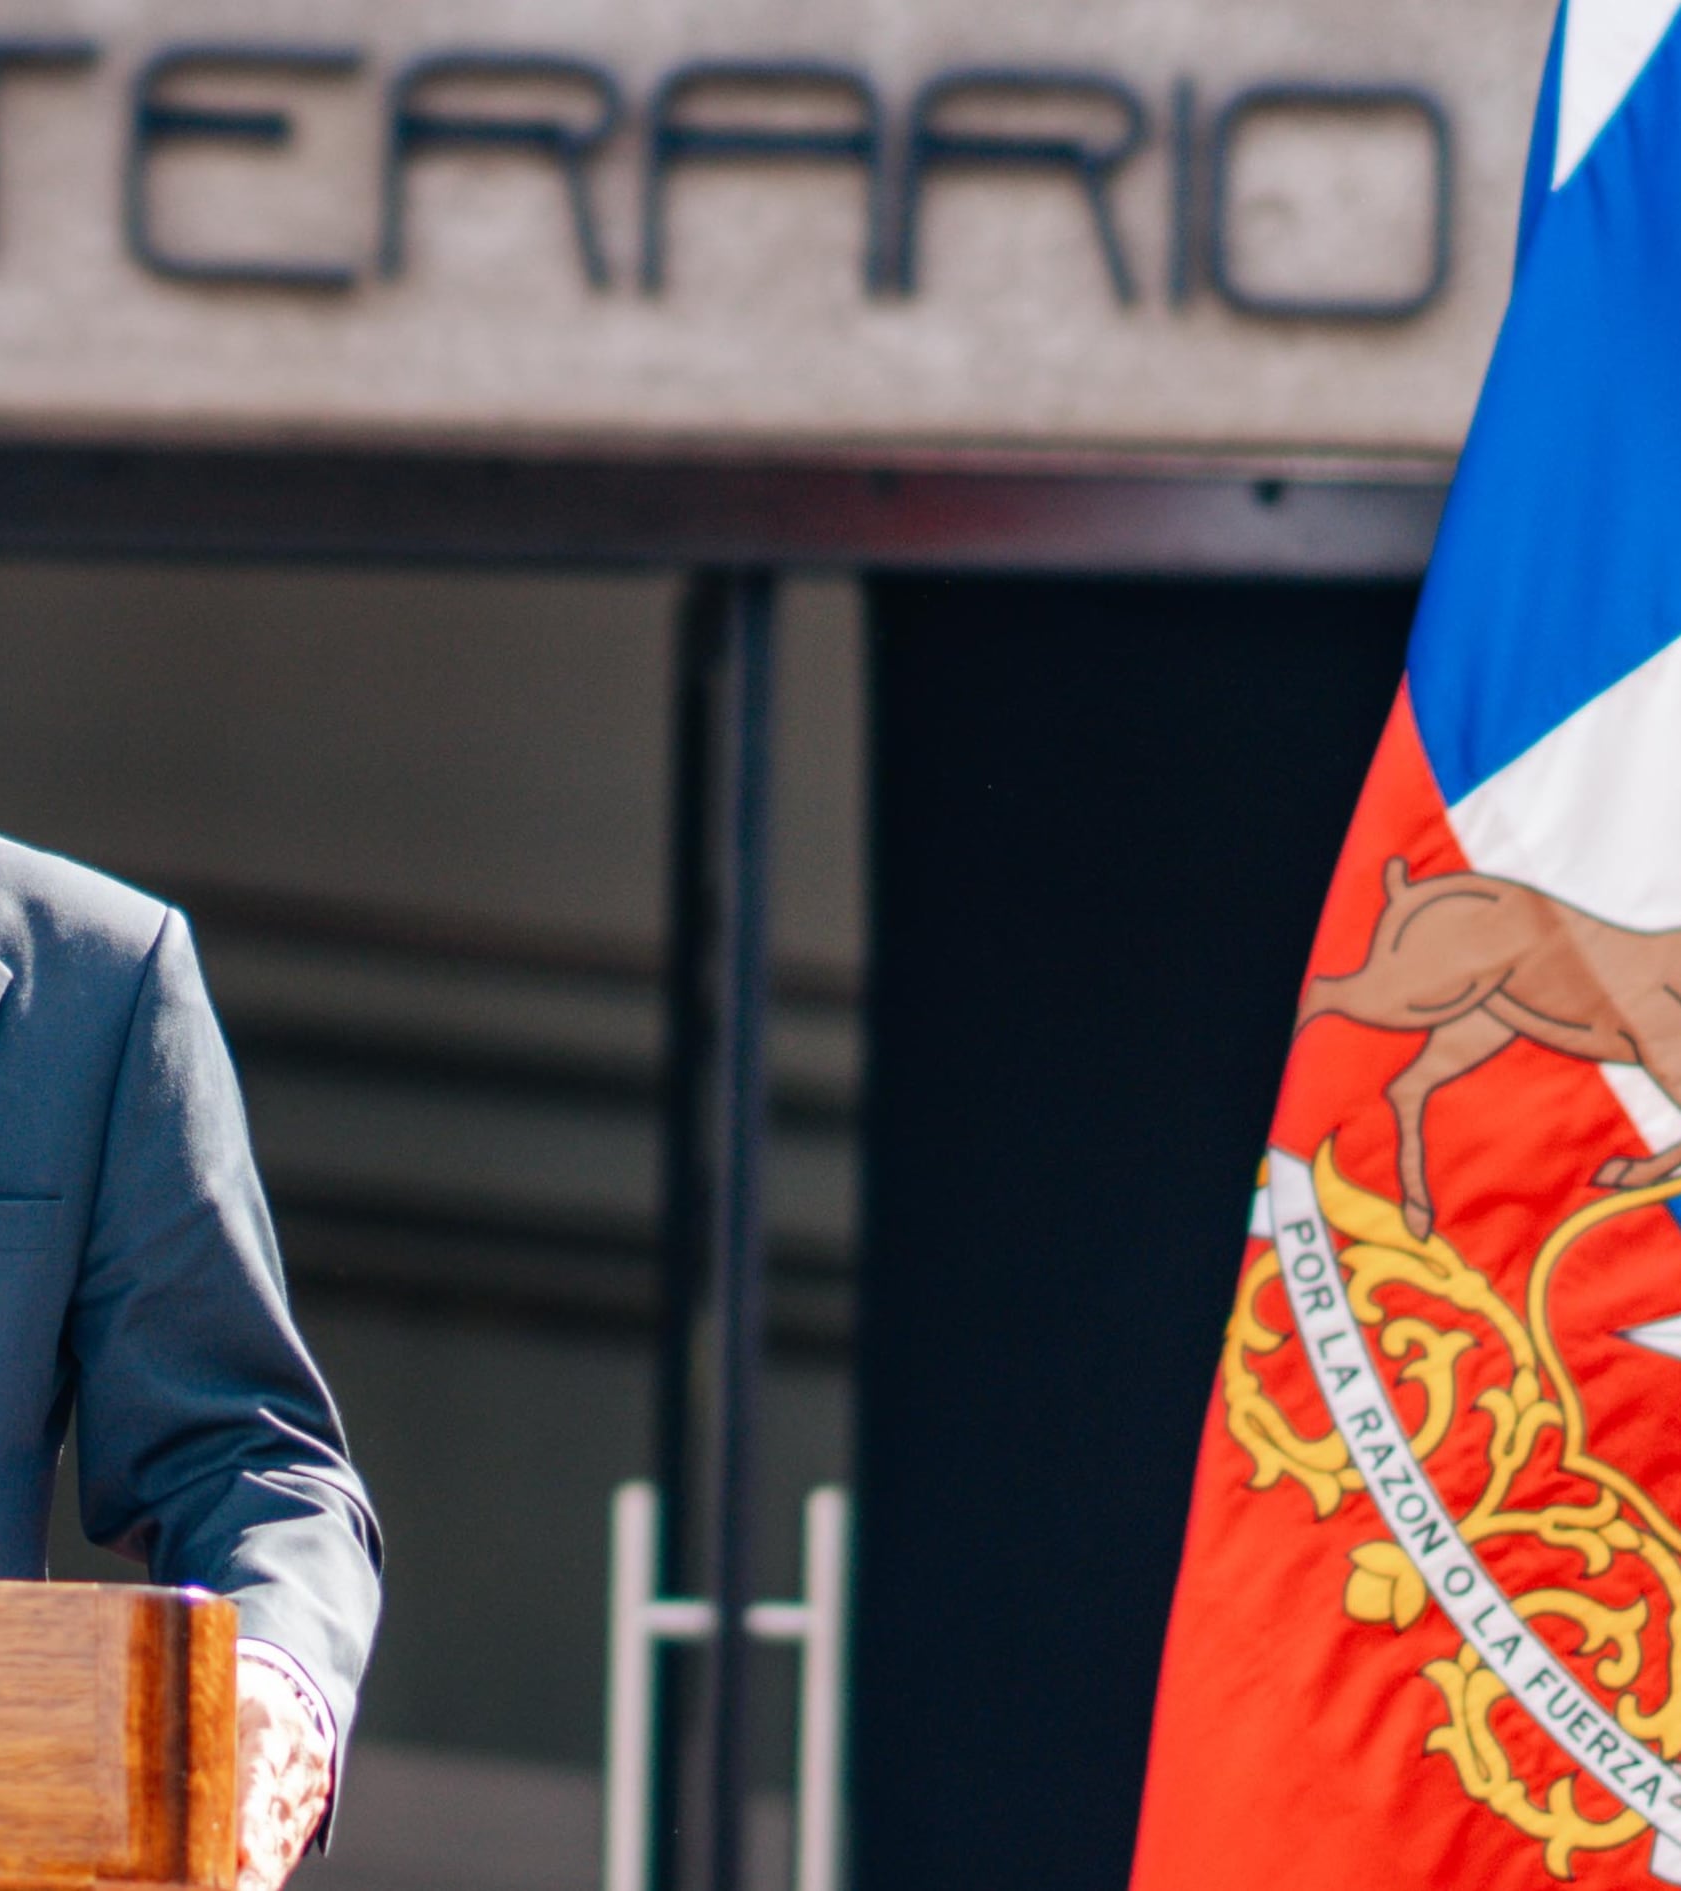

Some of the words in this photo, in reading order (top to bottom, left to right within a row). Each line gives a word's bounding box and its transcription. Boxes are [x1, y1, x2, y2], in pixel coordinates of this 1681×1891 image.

[1282, 1218, 1335, 1315] POR
[1317, 1332, 1361, 1392] LA
[1348, 1407, 1449, 1555] RAZON
[1443, 1566, 1476, 1598] O
[1472, 1605, 1522, 1665] LA
[1524, 1667, 1662, 1807] FUERZA
